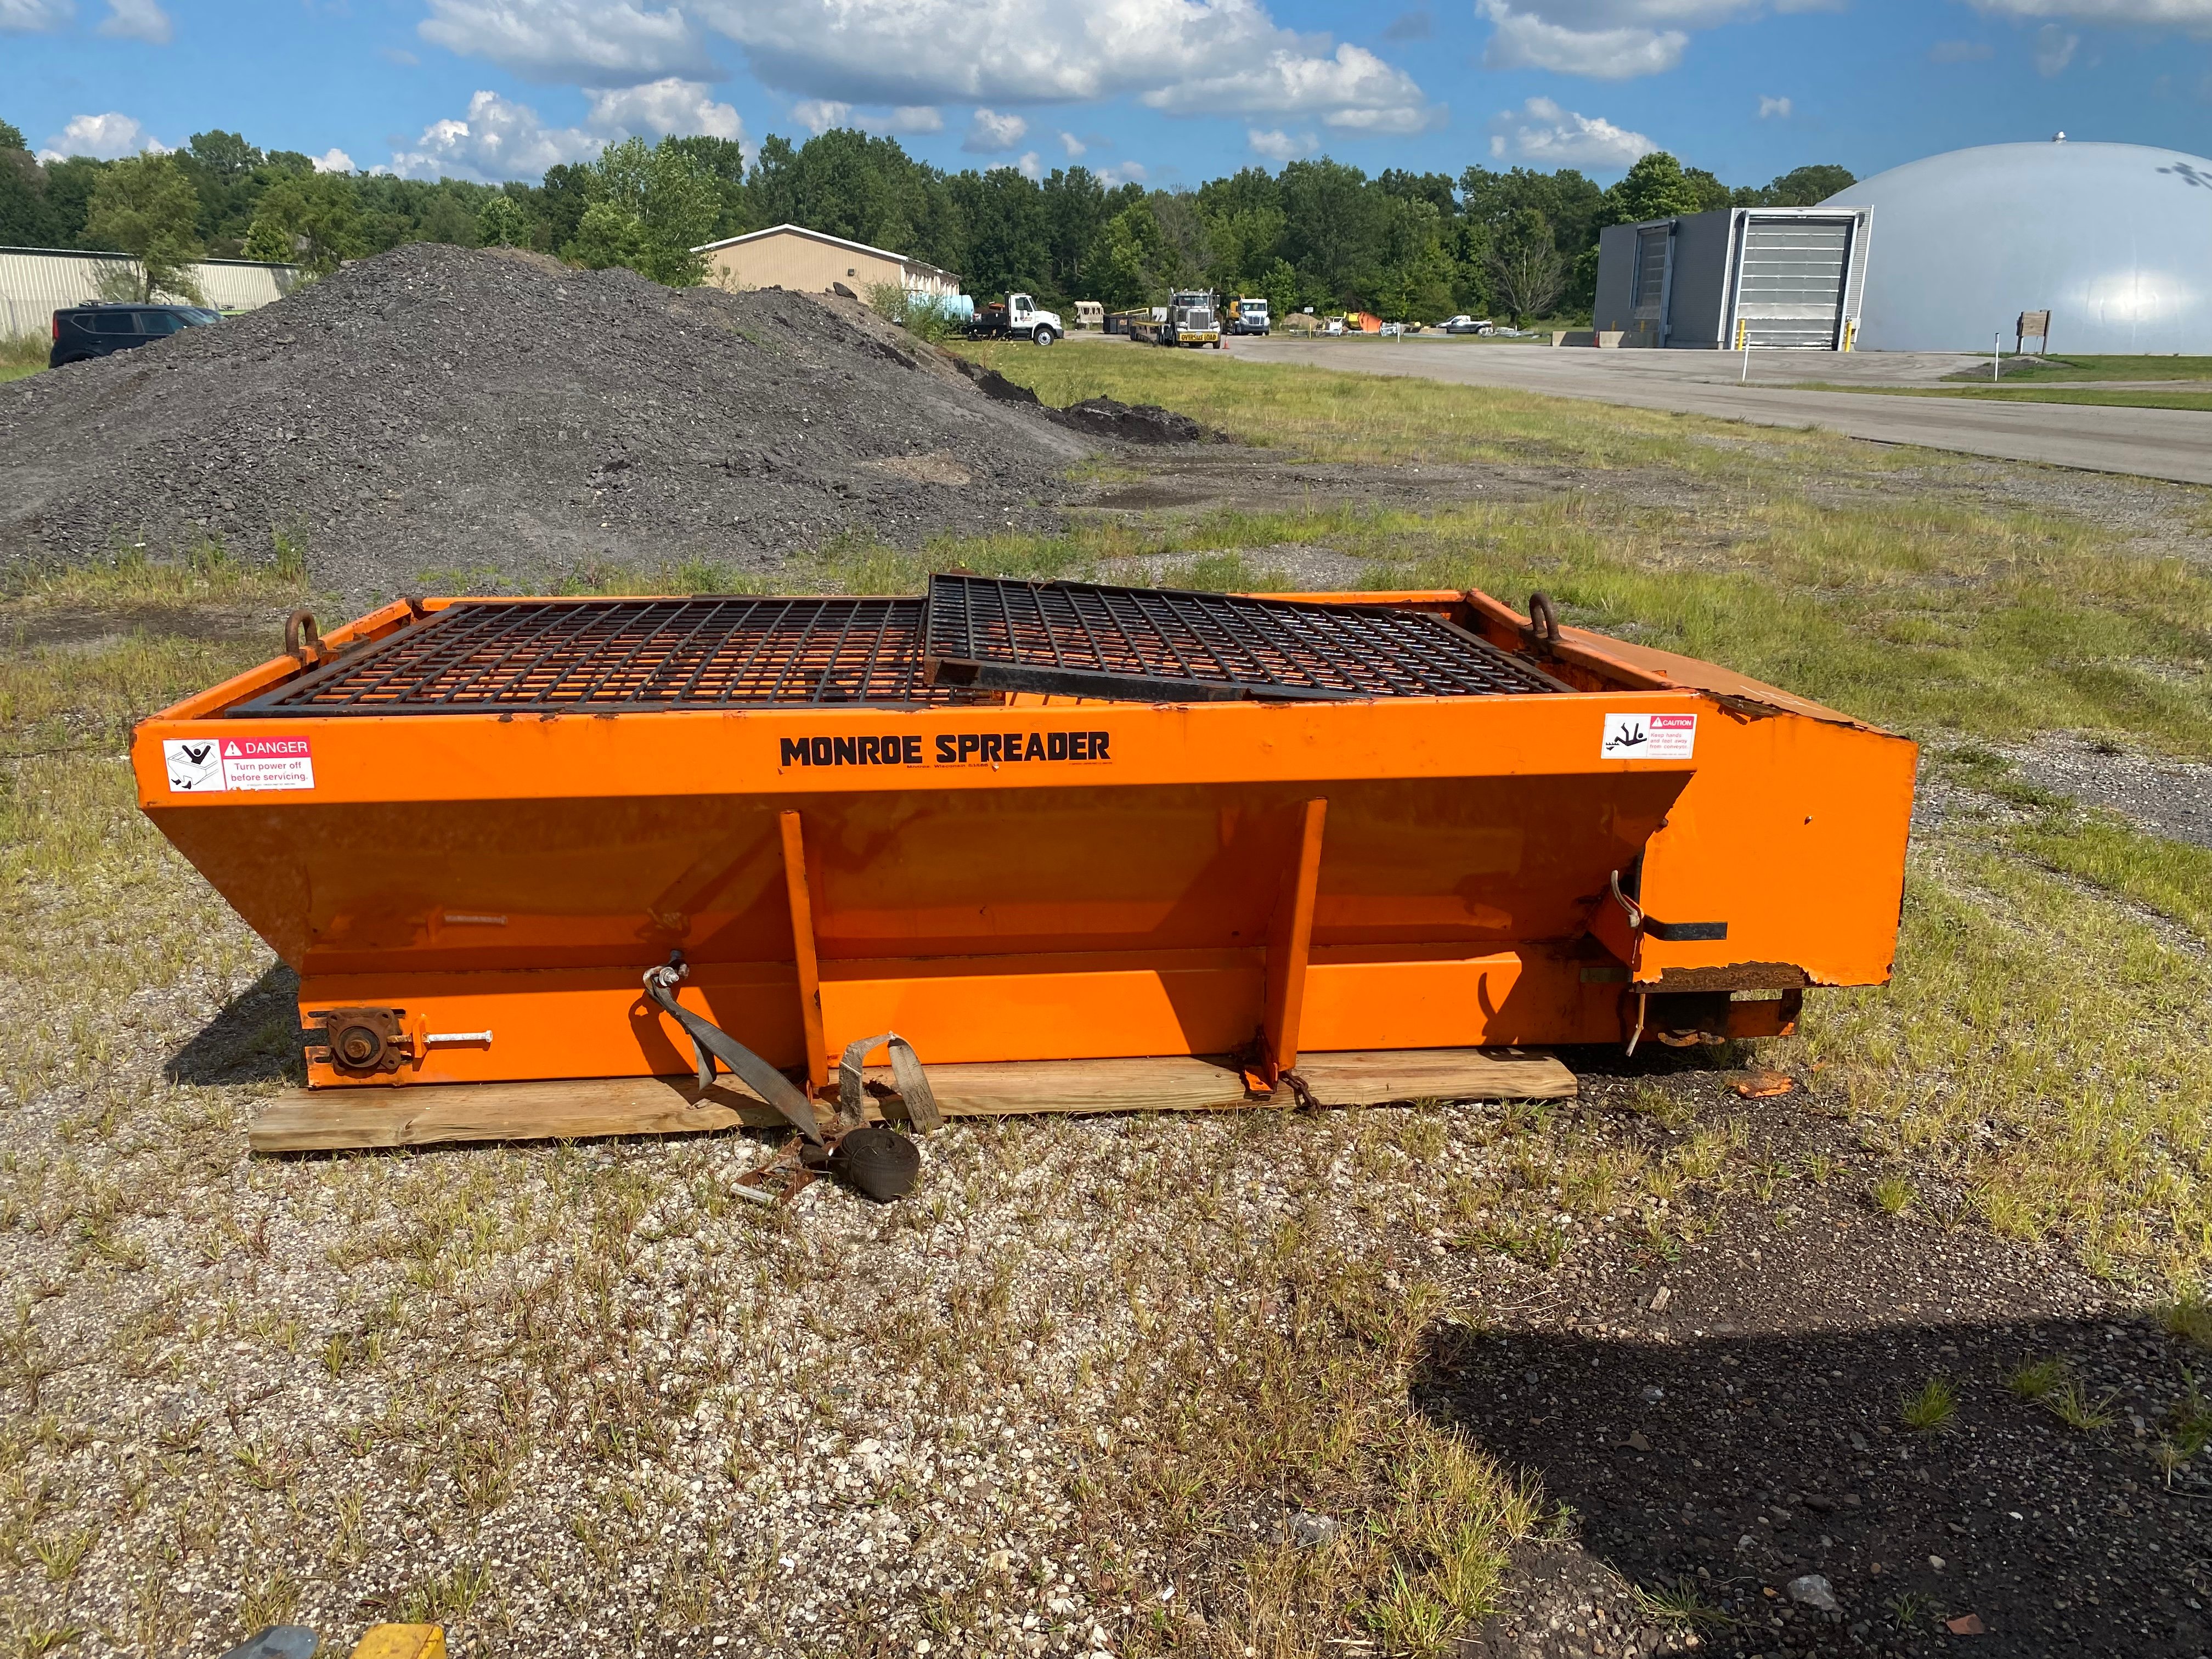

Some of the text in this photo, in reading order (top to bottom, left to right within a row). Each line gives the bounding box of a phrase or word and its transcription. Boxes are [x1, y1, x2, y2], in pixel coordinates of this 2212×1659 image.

[245, 741, 308, 754] DANGER
[780, 731, 1111, 766] MONROE SPREADER
[230, 772, 308, 782] before servicing.
